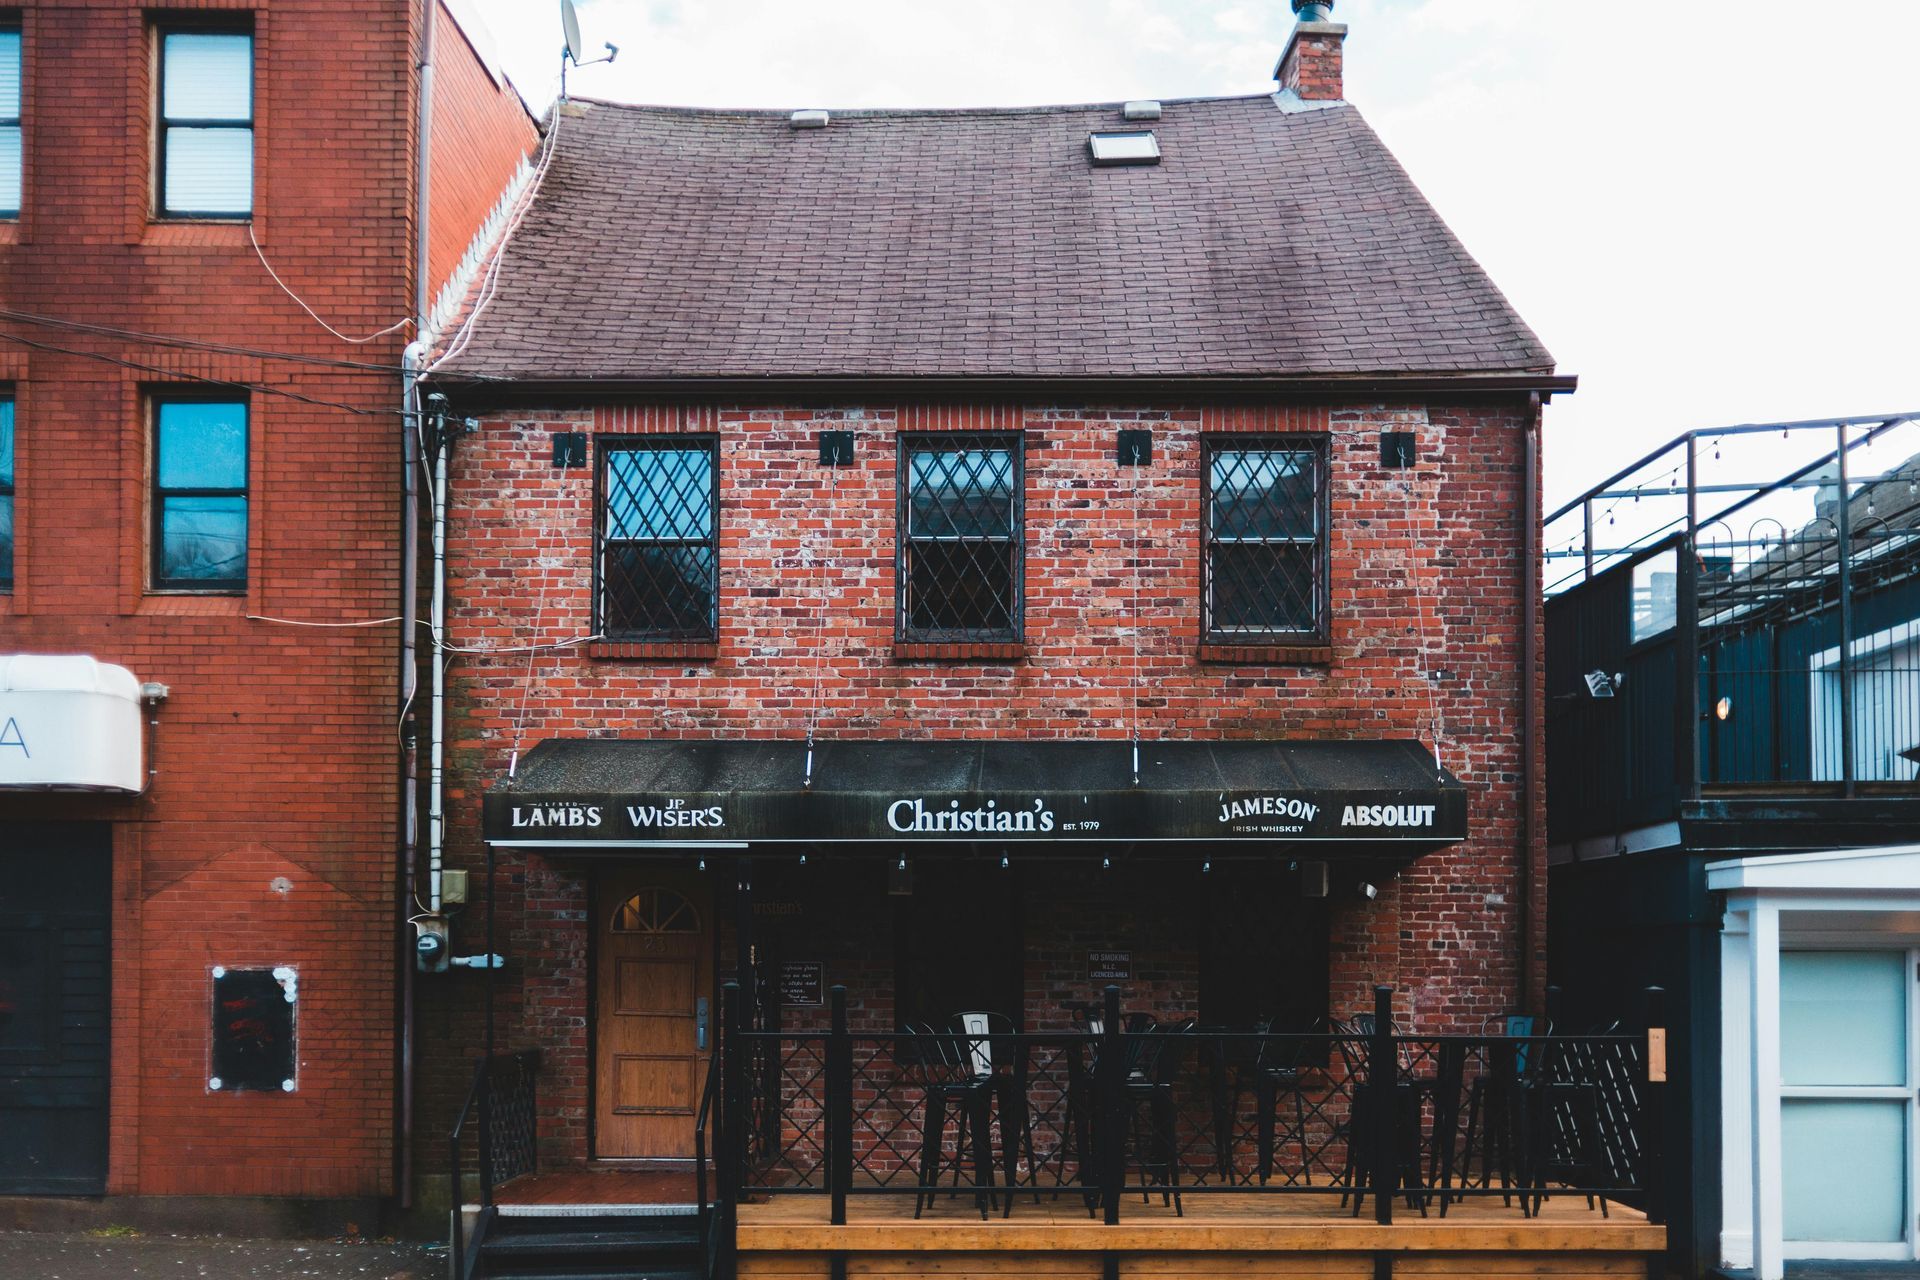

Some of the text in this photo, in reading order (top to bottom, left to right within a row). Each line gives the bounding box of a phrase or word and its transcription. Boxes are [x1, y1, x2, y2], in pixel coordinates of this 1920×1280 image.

[511, 806, 602, 827] LAMB'S
[887, 798, 1100, 832] Christian's EST. 1979
[1218, 797, 1318, 823] JAMESON
[1341, 805, 1436, 827] ABSOLUT
[1090, 953, 1129, 962] NO SMOKING
